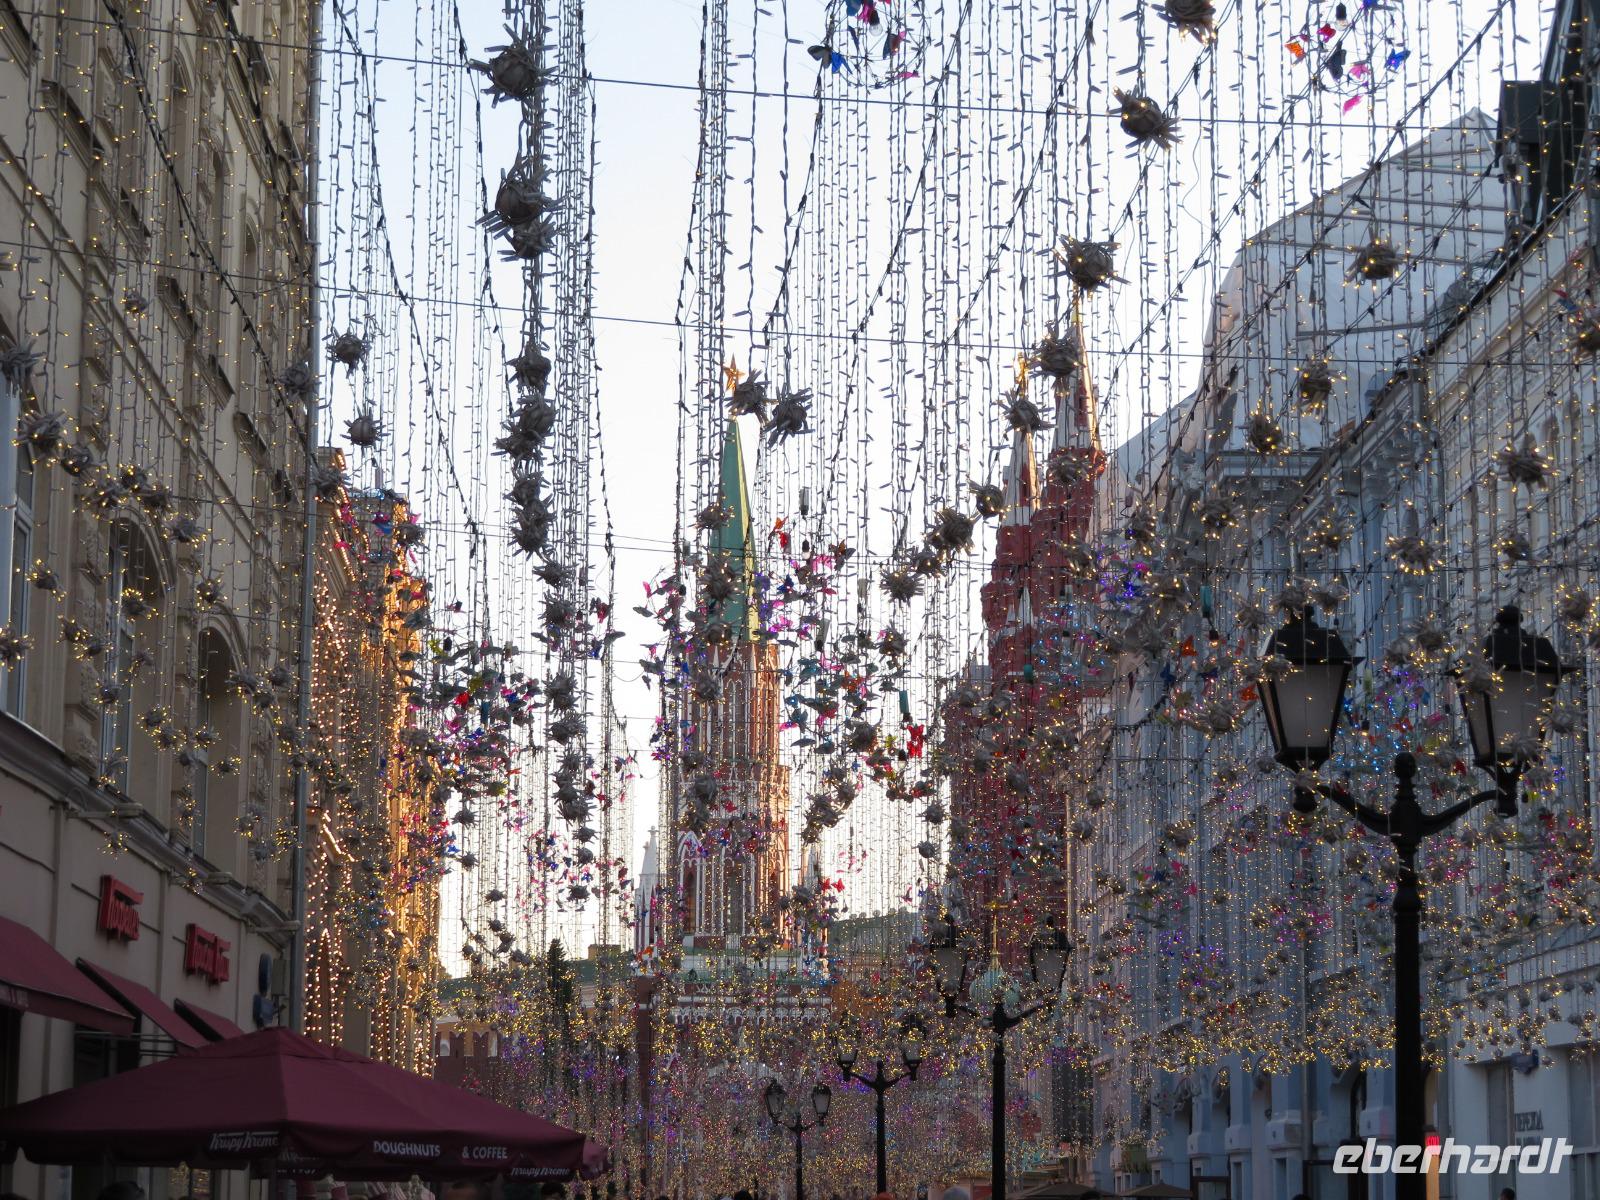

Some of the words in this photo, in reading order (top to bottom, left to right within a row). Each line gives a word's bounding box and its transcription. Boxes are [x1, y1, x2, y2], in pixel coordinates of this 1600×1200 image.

[209, 1132, 243, 1151] Krispy
[242, 1131, 279, 1149] Kreme
[372, 1140, 441, 1157] DOUGHNUTS
[462, 1146, 470, 1159] &
[472, 1146, 509, 1160] COFFEE
